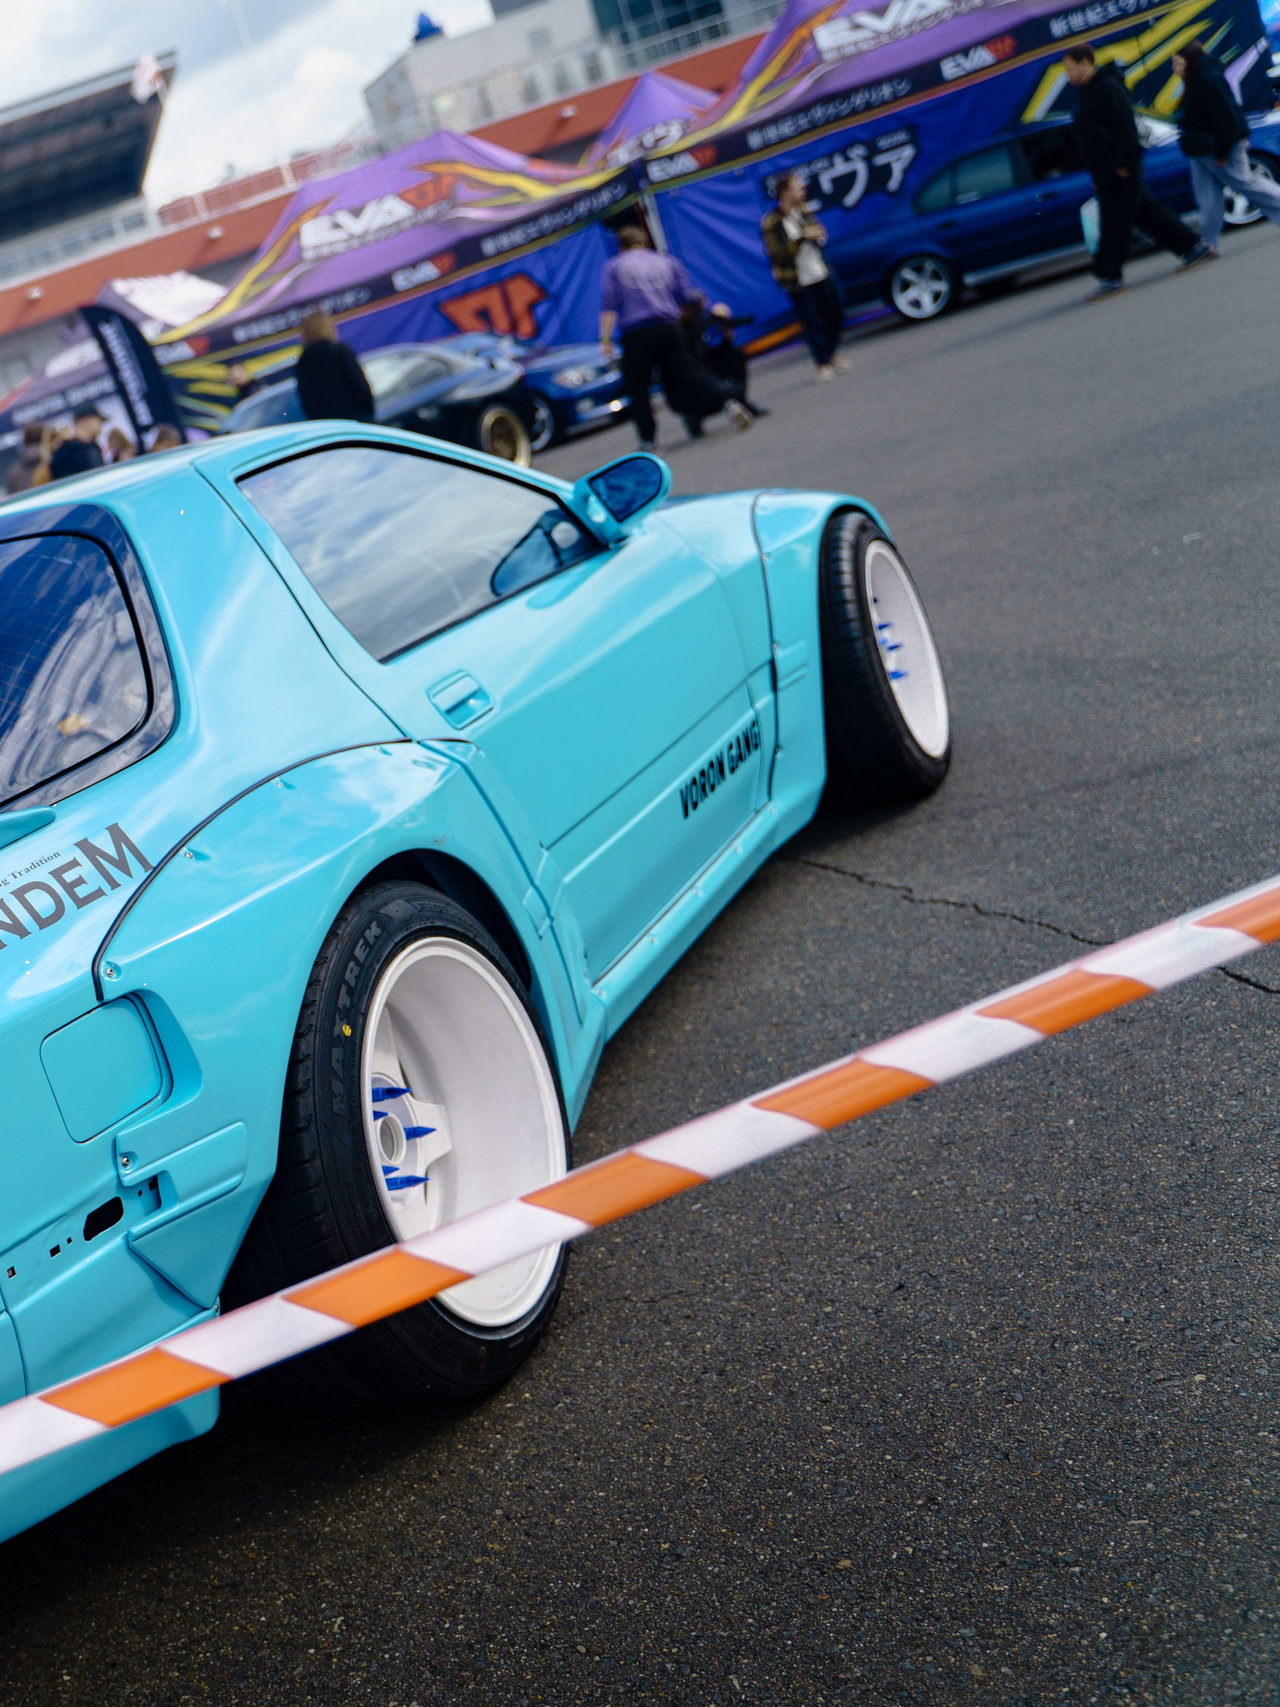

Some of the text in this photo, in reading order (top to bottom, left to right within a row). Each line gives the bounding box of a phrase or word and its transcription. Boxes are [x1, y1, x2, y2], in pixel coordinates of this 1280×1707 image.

[680, 719, 761, 820] VORON GANG
[8, 851, 61, 880] Tradition
[332, 920, 383, 1117] MAXTREK
